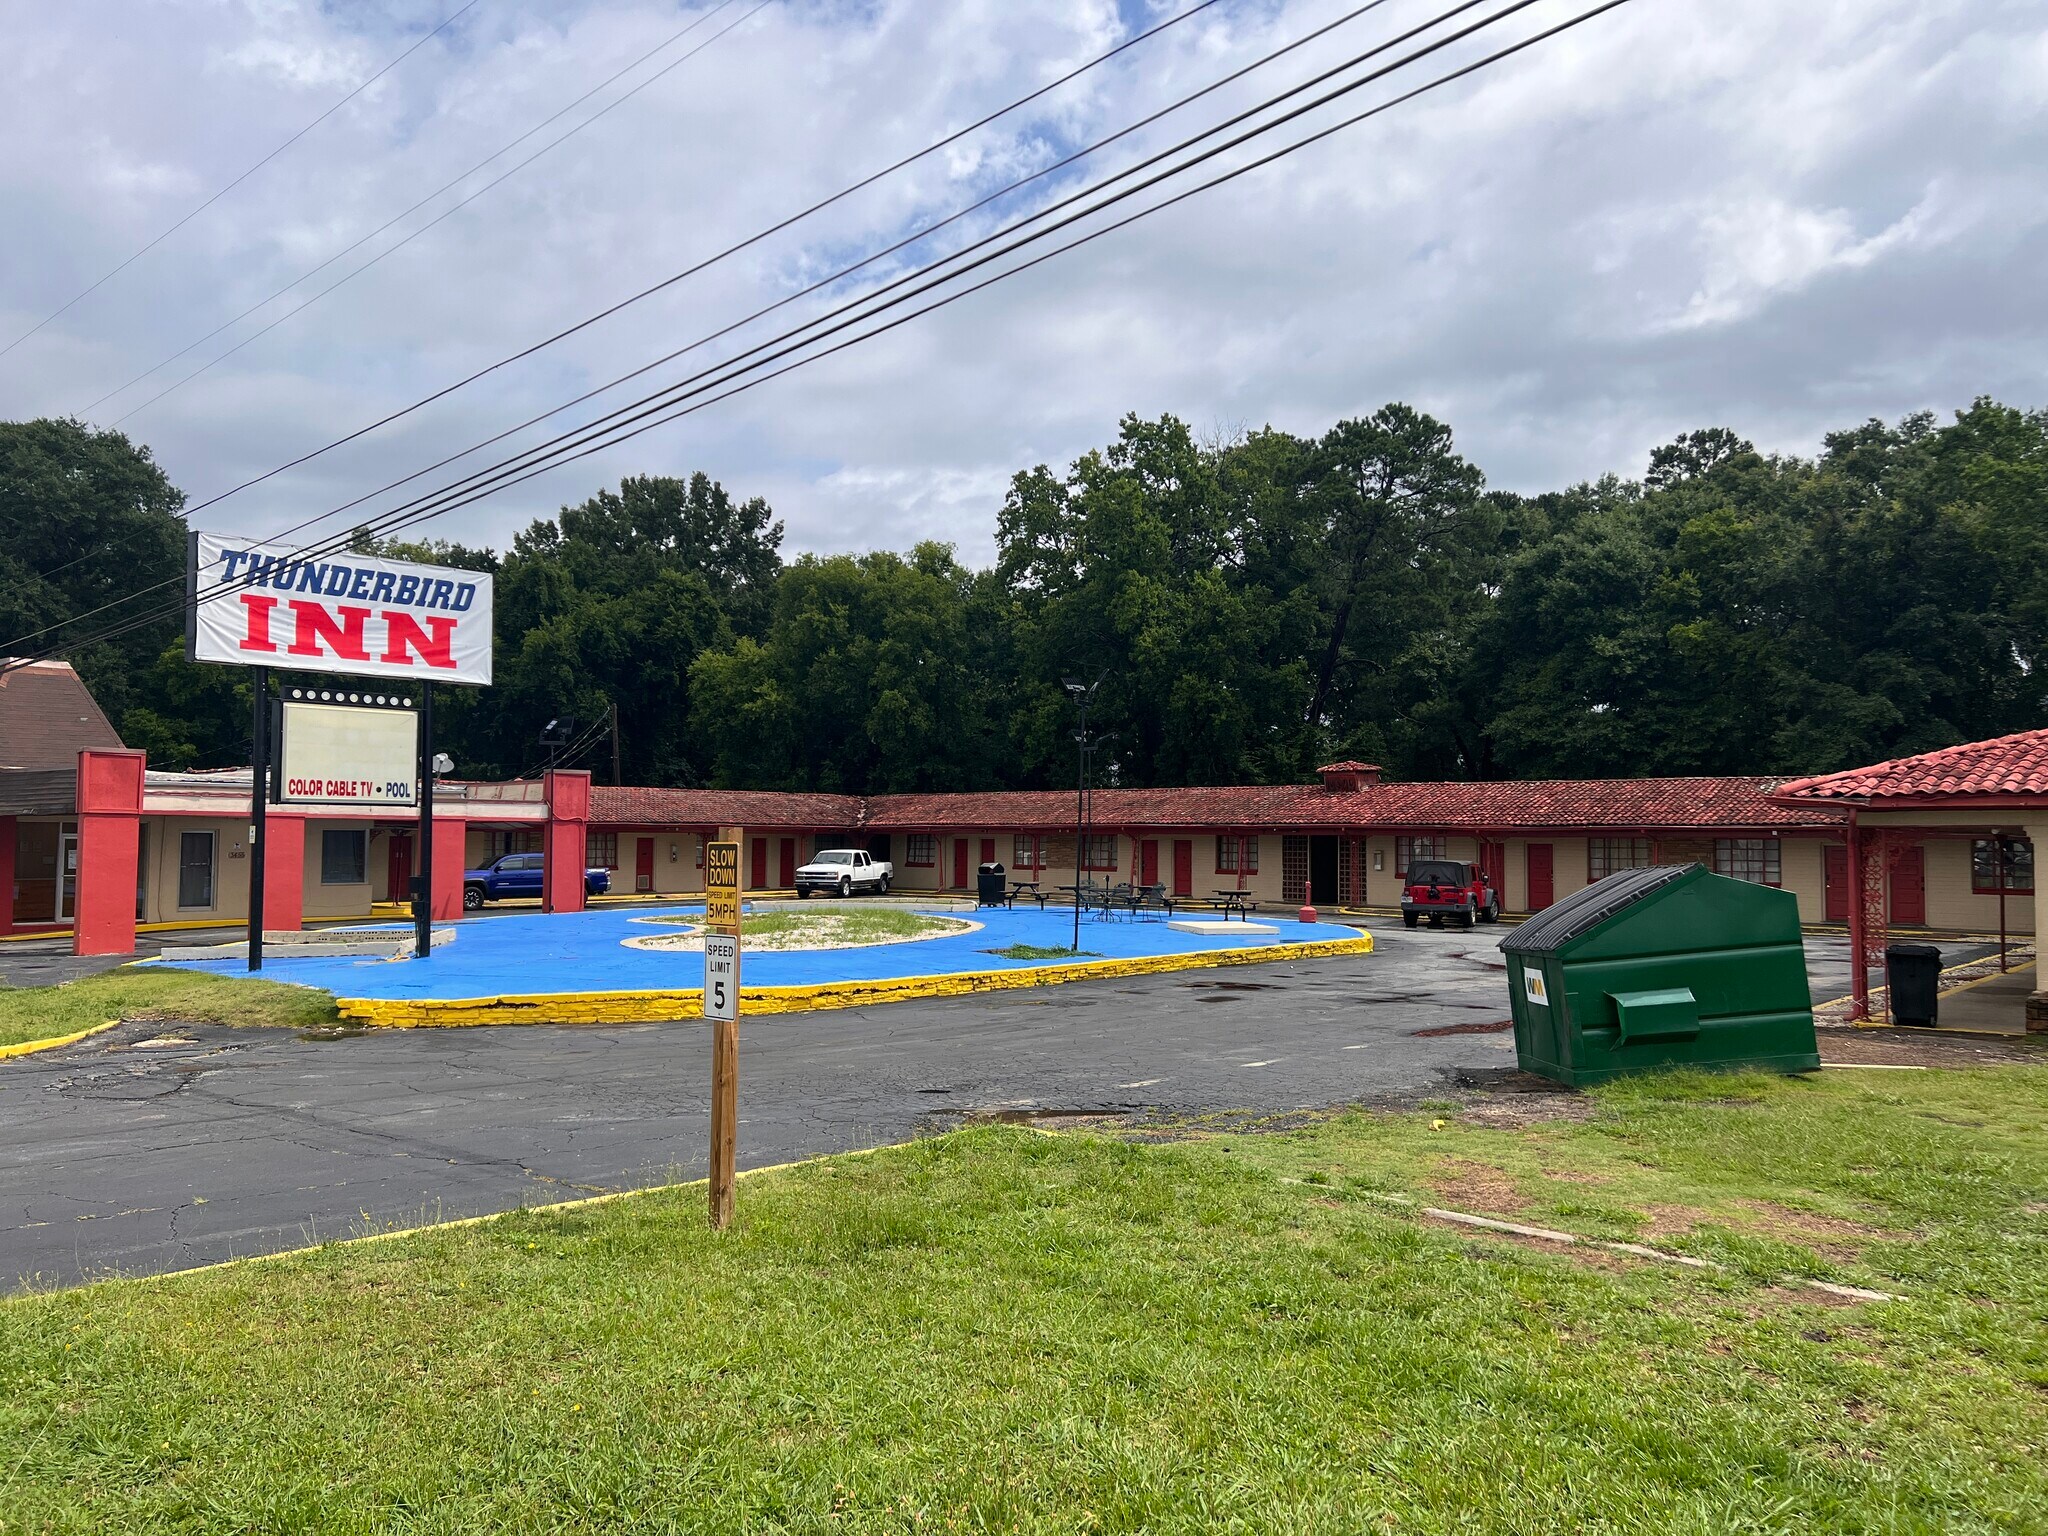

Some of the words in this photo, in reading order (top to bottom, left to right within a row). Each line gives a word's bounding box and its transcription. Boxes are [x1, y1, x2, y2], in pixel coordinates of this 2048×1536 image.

[219, 549, 476, 612] THUNDERBIRD
[239, 593, 458, 669] INN
[288, 779, 323, 796] COLOR
[326, 780, 357, 796] CABLE
[360, 782, 373, 797] TV
[385, 782, 411, 798] POOL
[709, 849, 736, 866] SLOW
[709, 867, 735, 885] DOWN
[708, 890, 723, 899] SPEED
[724, 891, 736, 900] LIMIT
[707, 944, 734, 957] SPEED
[710, 961, 731, 973] LIMIT
[1526, 976, 1544, 996] WM
[714, 981, 726, 1010] 5
